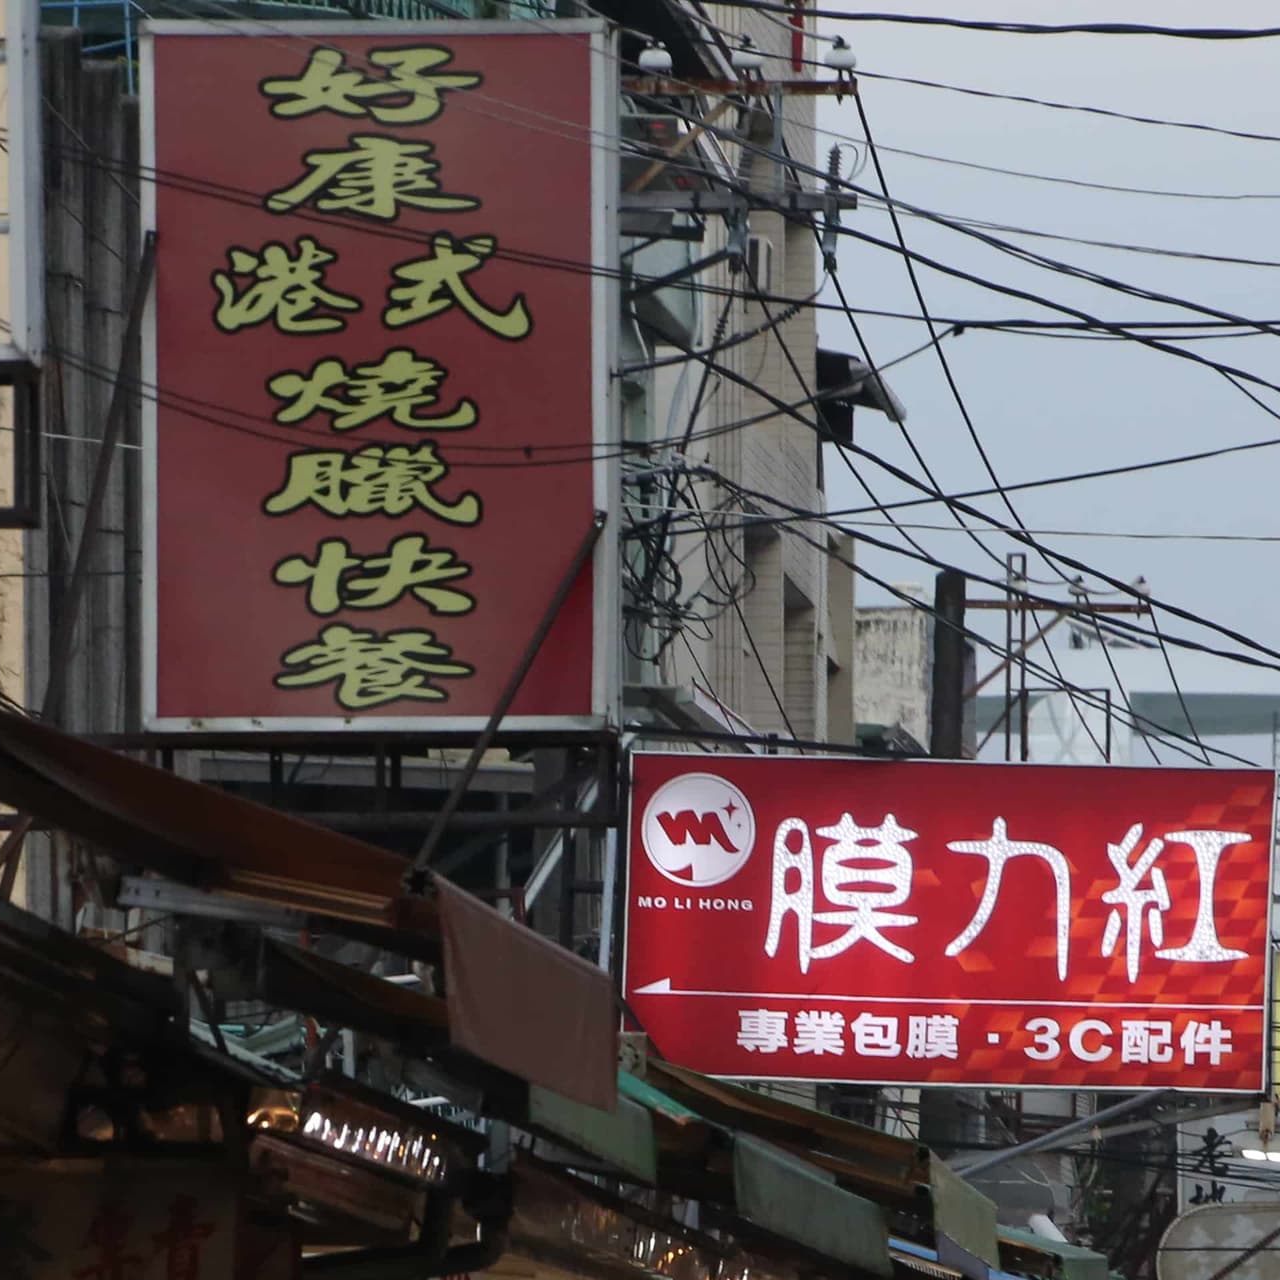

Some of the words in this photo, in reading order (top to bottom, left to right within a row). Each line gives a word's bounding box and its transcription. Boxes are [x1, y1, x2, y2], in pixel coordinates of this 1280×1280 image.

[637, 895, 669, 910] MO
[673, 896, 693, 911] LI
[697, 897, 754, 912] HONG
[764, 811, 1253, 984] 膜力紅
